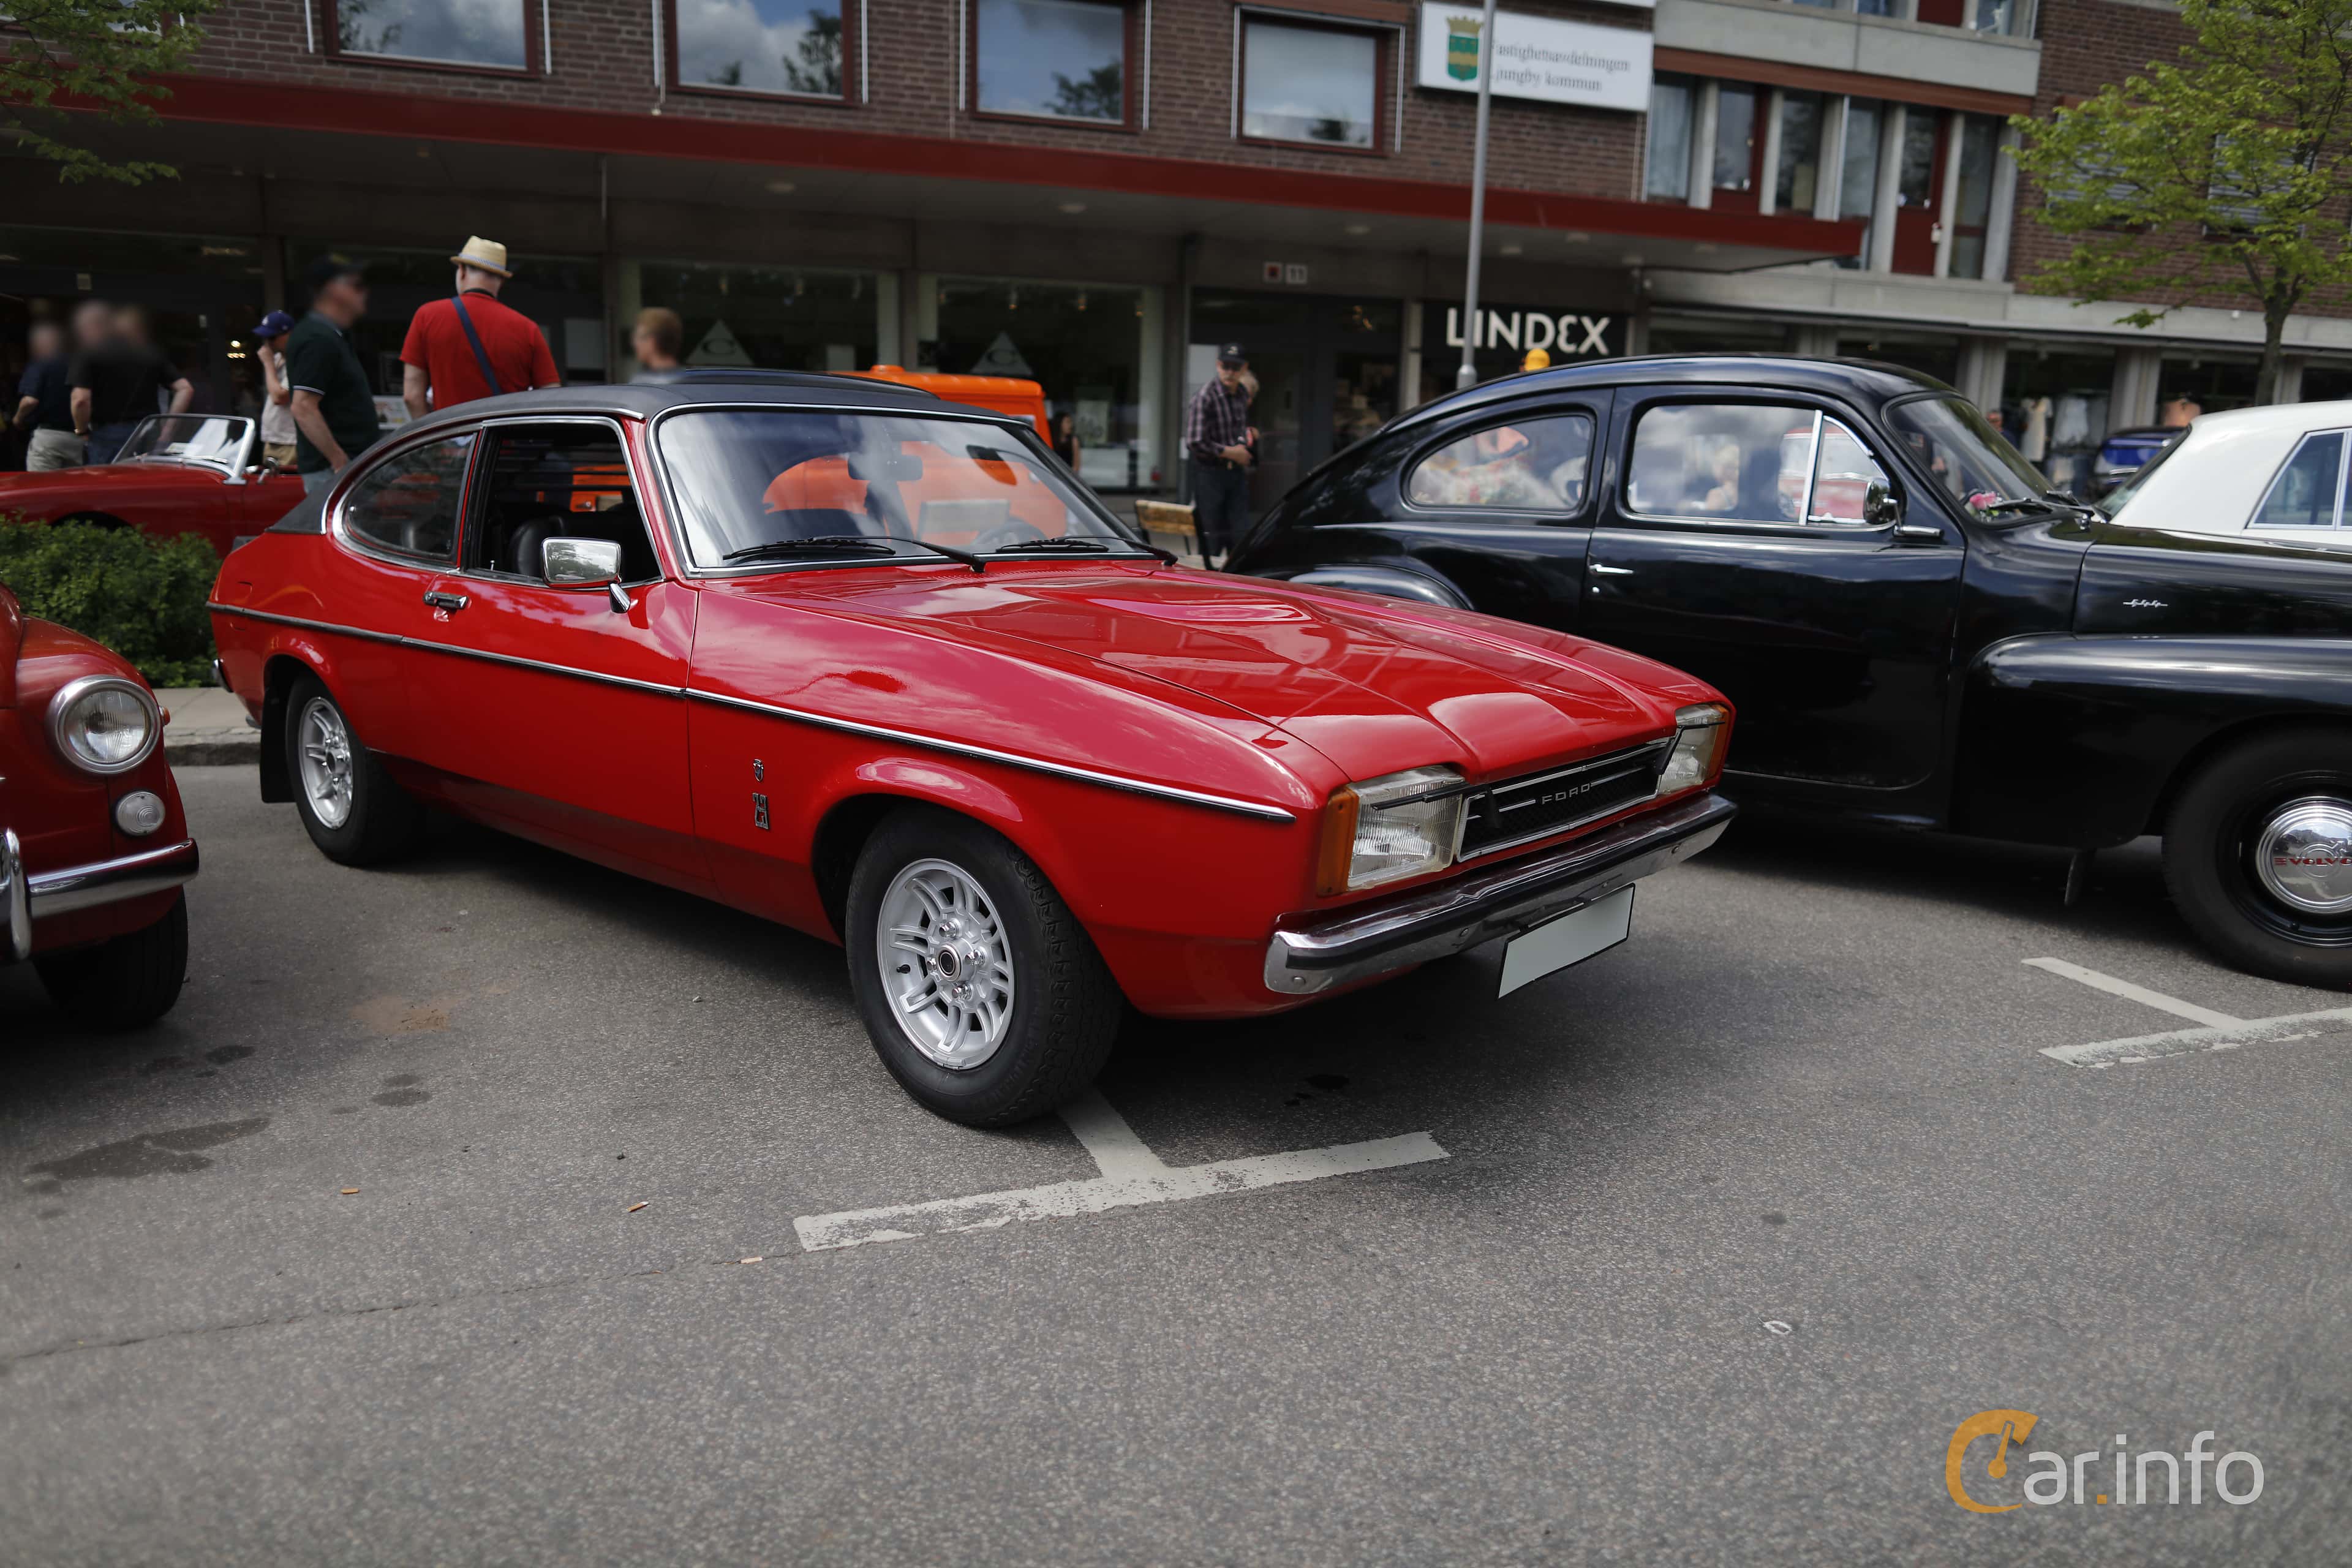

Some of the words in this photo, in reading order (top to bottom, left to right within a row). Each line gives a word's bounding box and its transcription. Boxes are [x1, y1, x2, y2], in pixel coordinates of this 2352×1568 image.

[1446, 307, 1611, 355] LINDEX
[1542, 783, 1591, 805] FORD
[2288, 857, 2352, 866] VOLVO
